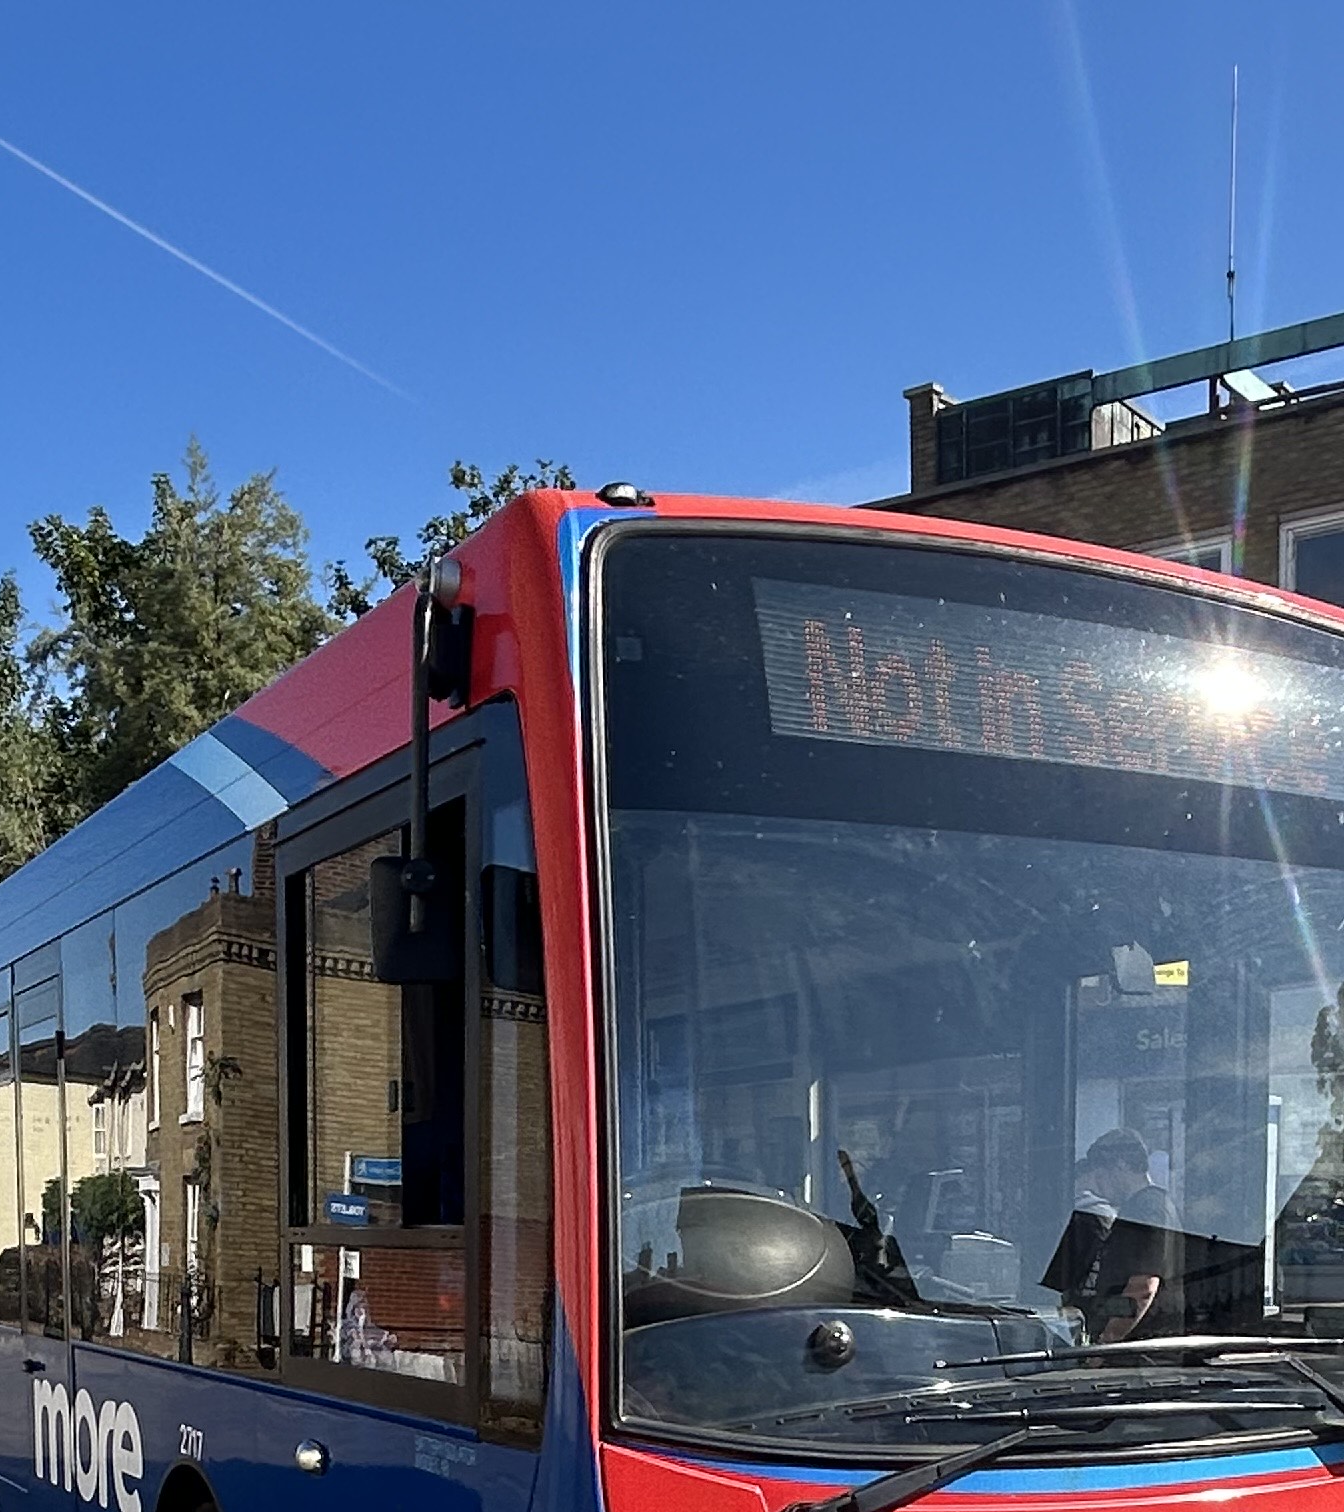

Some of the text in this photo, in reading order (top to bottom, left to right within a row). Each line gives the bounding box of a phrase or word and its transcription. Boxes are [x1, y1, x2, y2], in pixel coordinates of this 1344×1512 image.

[804, 618, 961, 750] Not
[975, 646, 1045, 758] in
[179, 1423, 204, 1461] 2717
